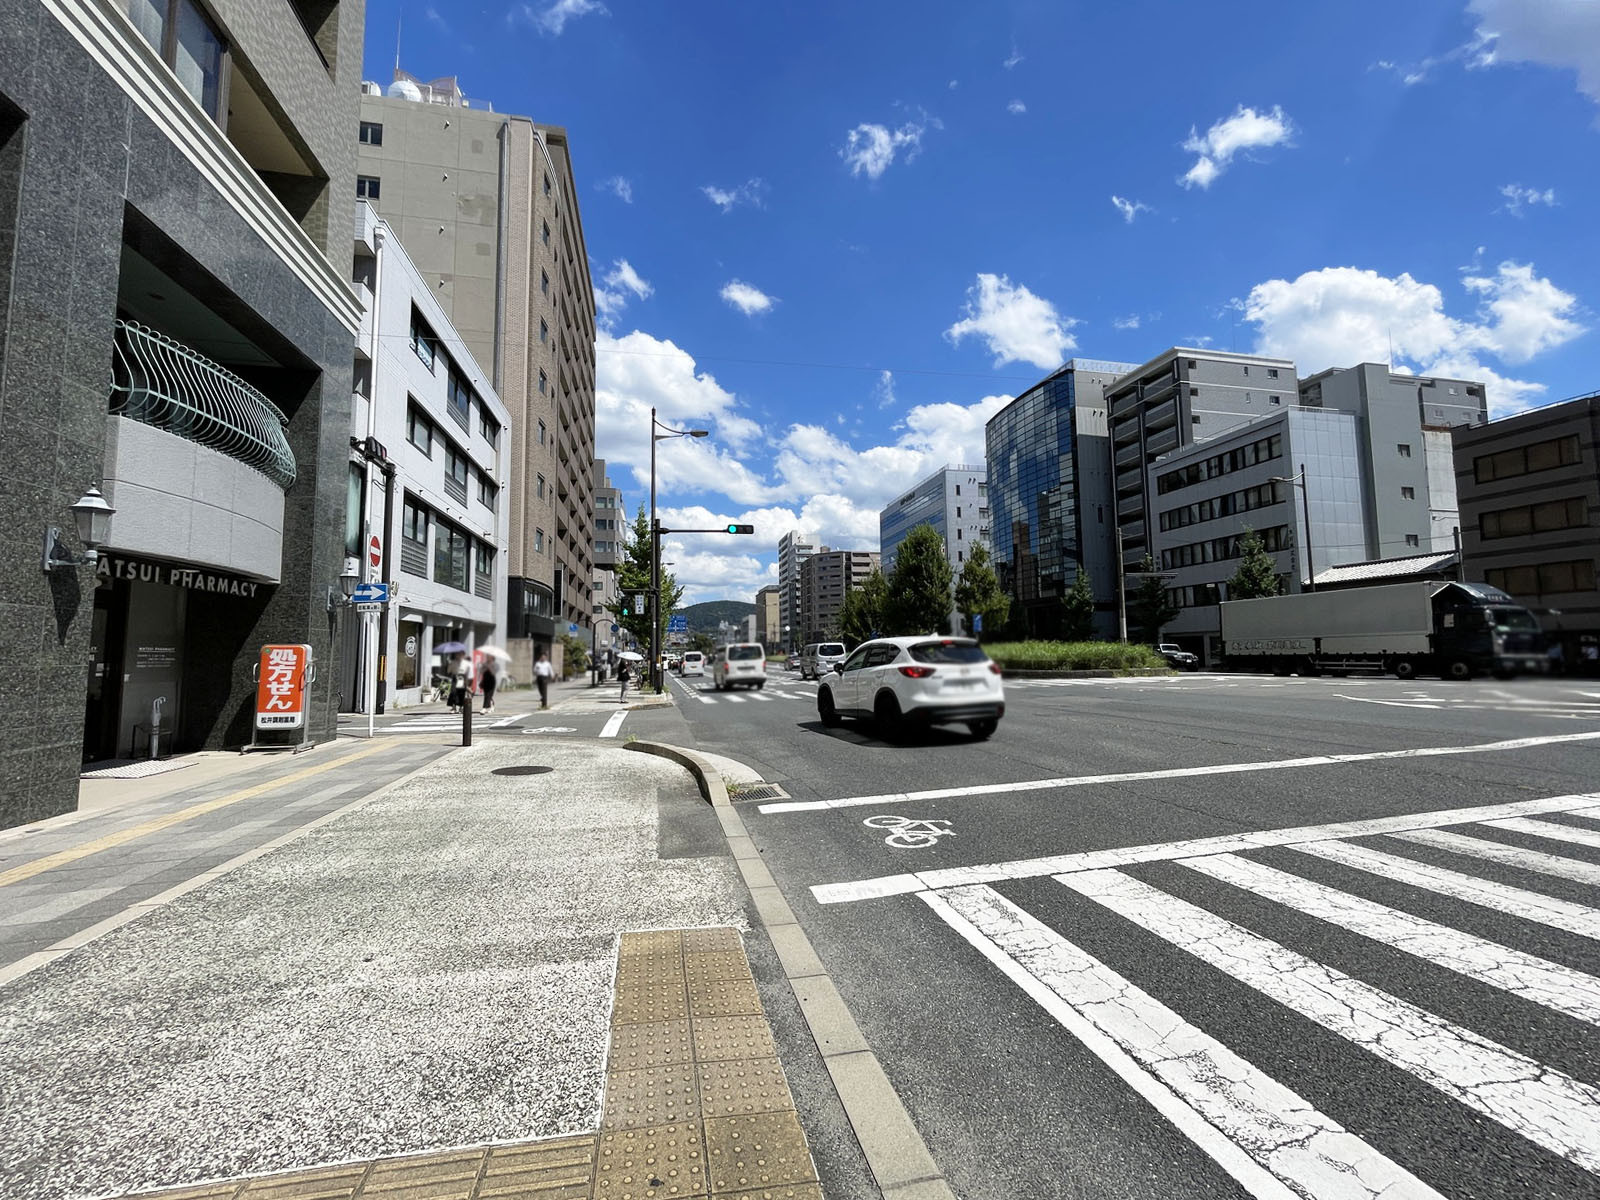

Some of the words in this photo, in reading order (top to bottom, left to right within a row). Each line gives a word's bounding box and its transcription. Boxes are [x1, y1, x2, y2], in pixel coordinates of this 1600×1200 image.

[170, 569, 258, 598] PHARMACY
[266, 649, 297, 710] 処方せん
